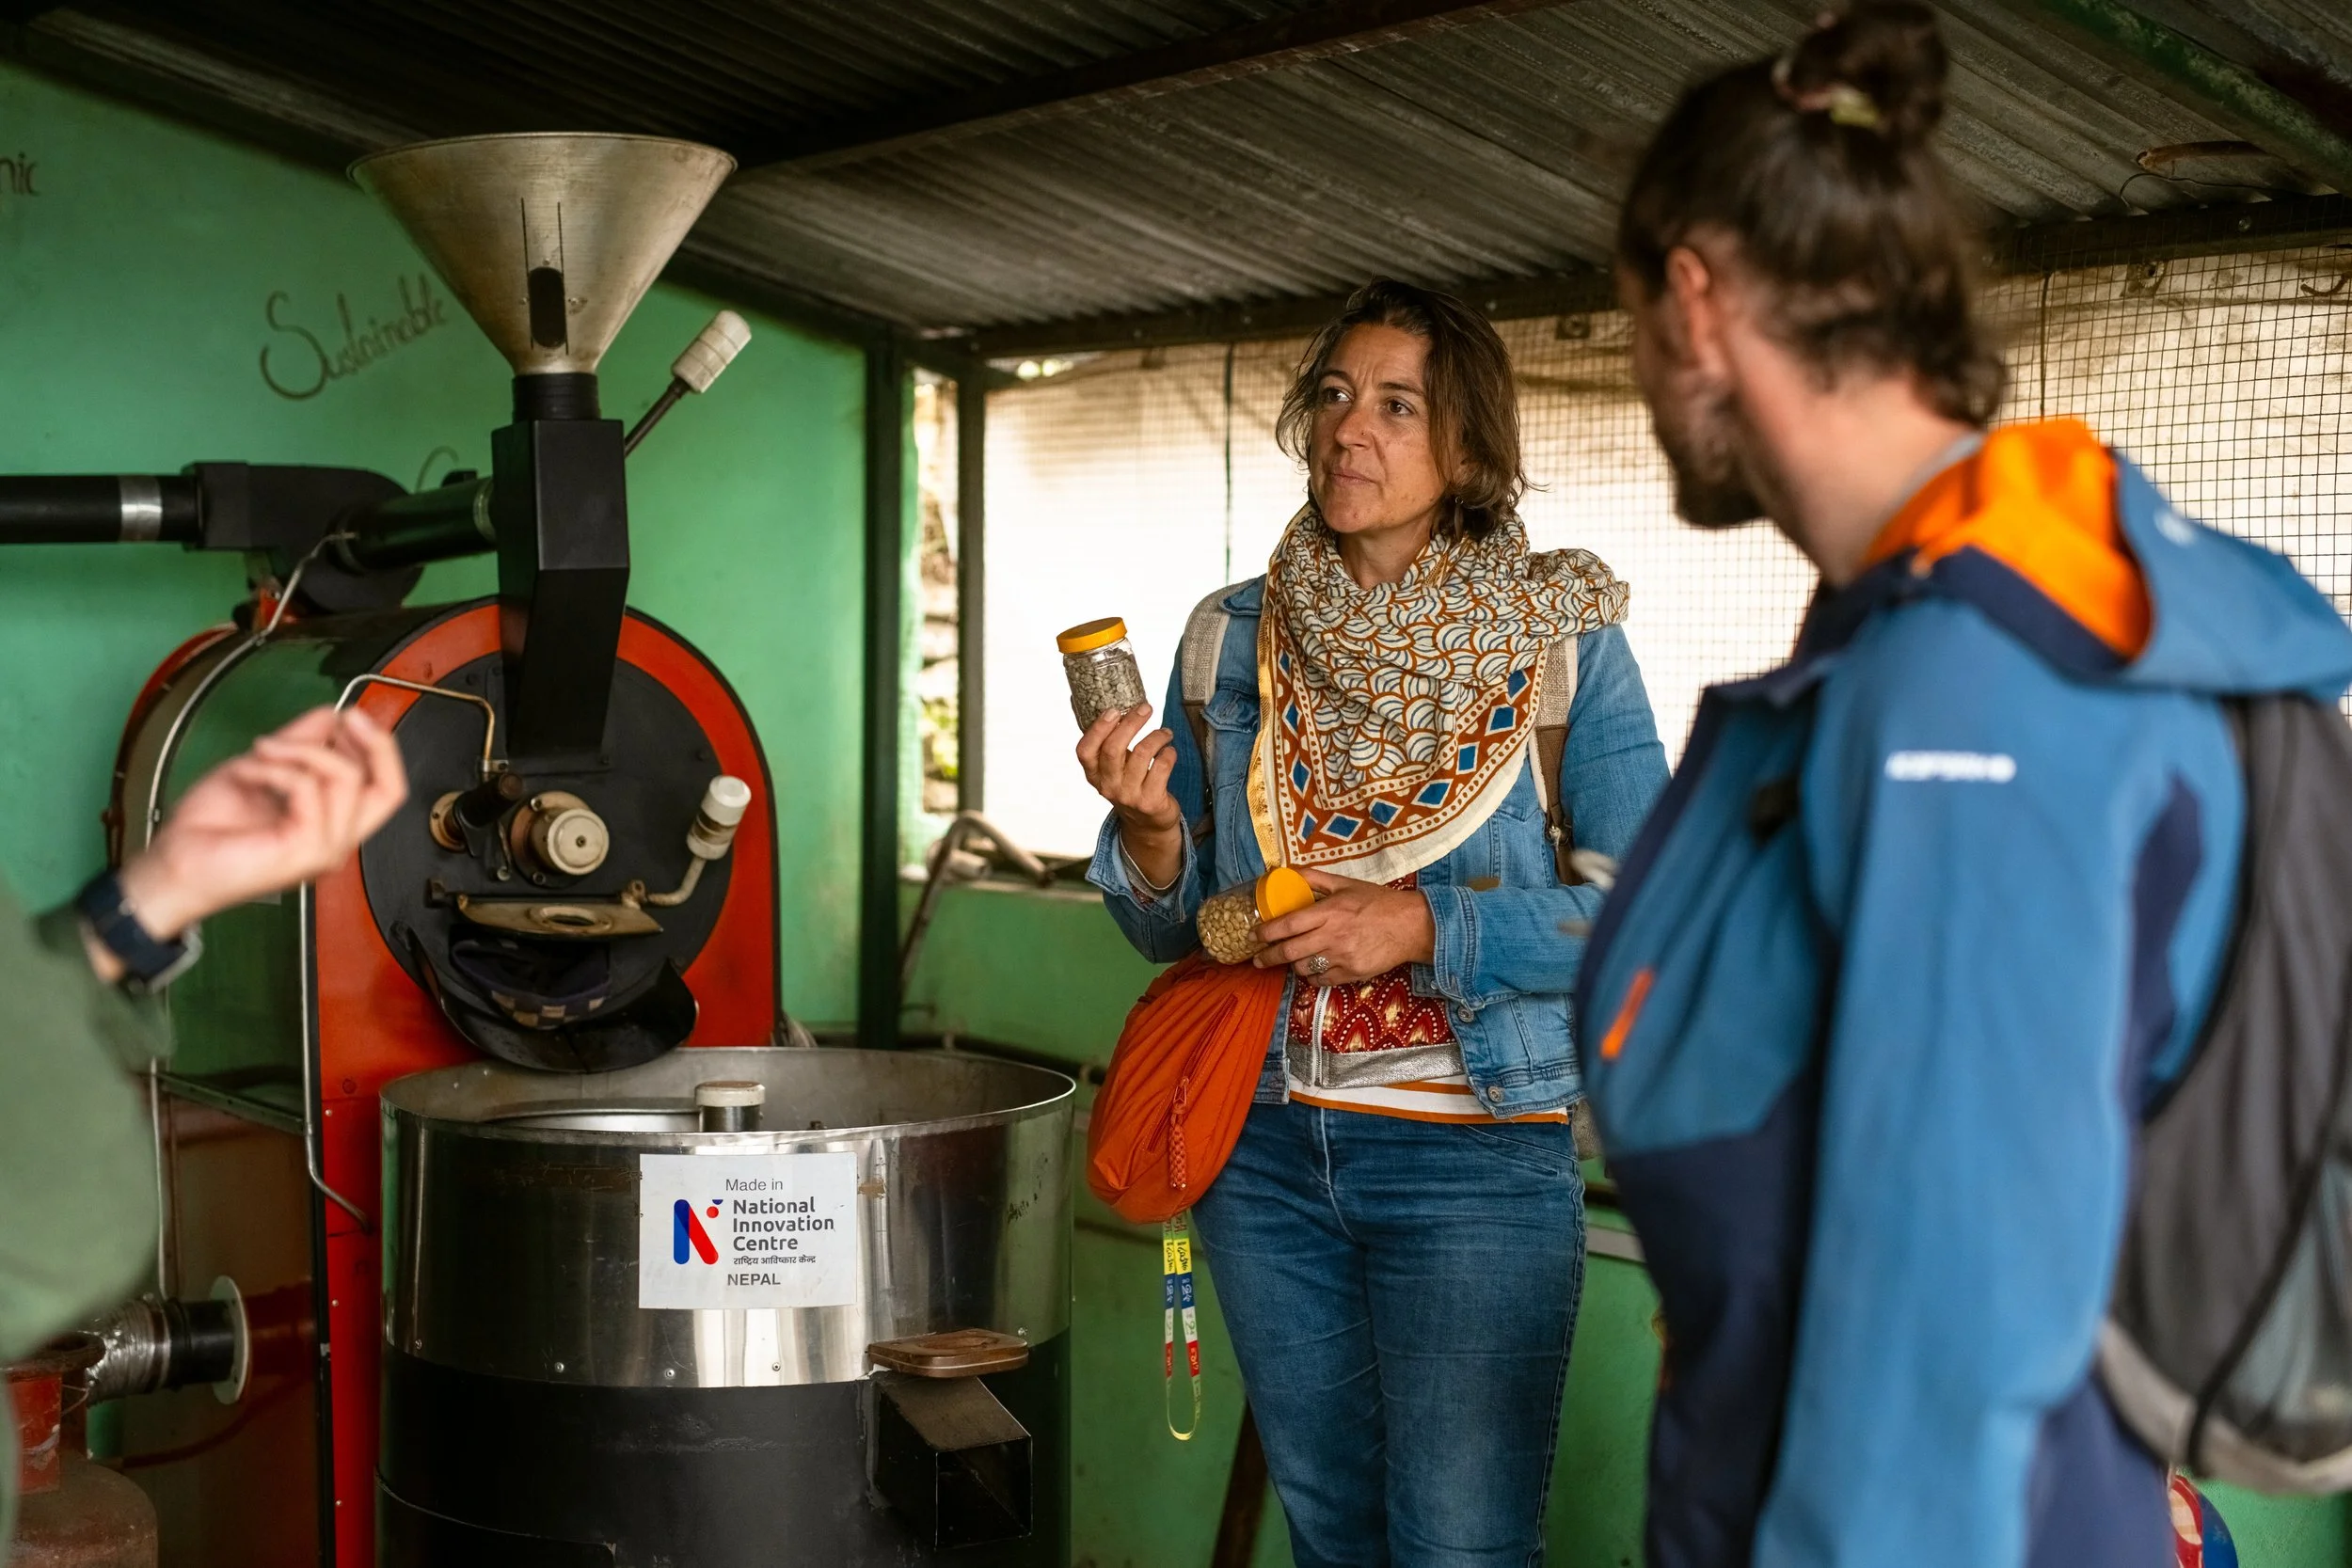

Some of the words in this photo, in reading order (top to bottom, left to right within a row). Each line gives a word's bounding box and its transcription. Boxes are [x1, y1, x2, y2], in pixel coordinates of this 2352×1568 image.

[260, 271, 449, 401] Sustainable
[725, 1178, 767, 1192] Made
[771, 1178, 784, 1191] in
[733, 1196, 816, 1214] National
[733, 1215, 834, 1233] Innovation
[733, 1235, 799, 1251] Centre
[727, 1273, 781, 1286] NEPAL
